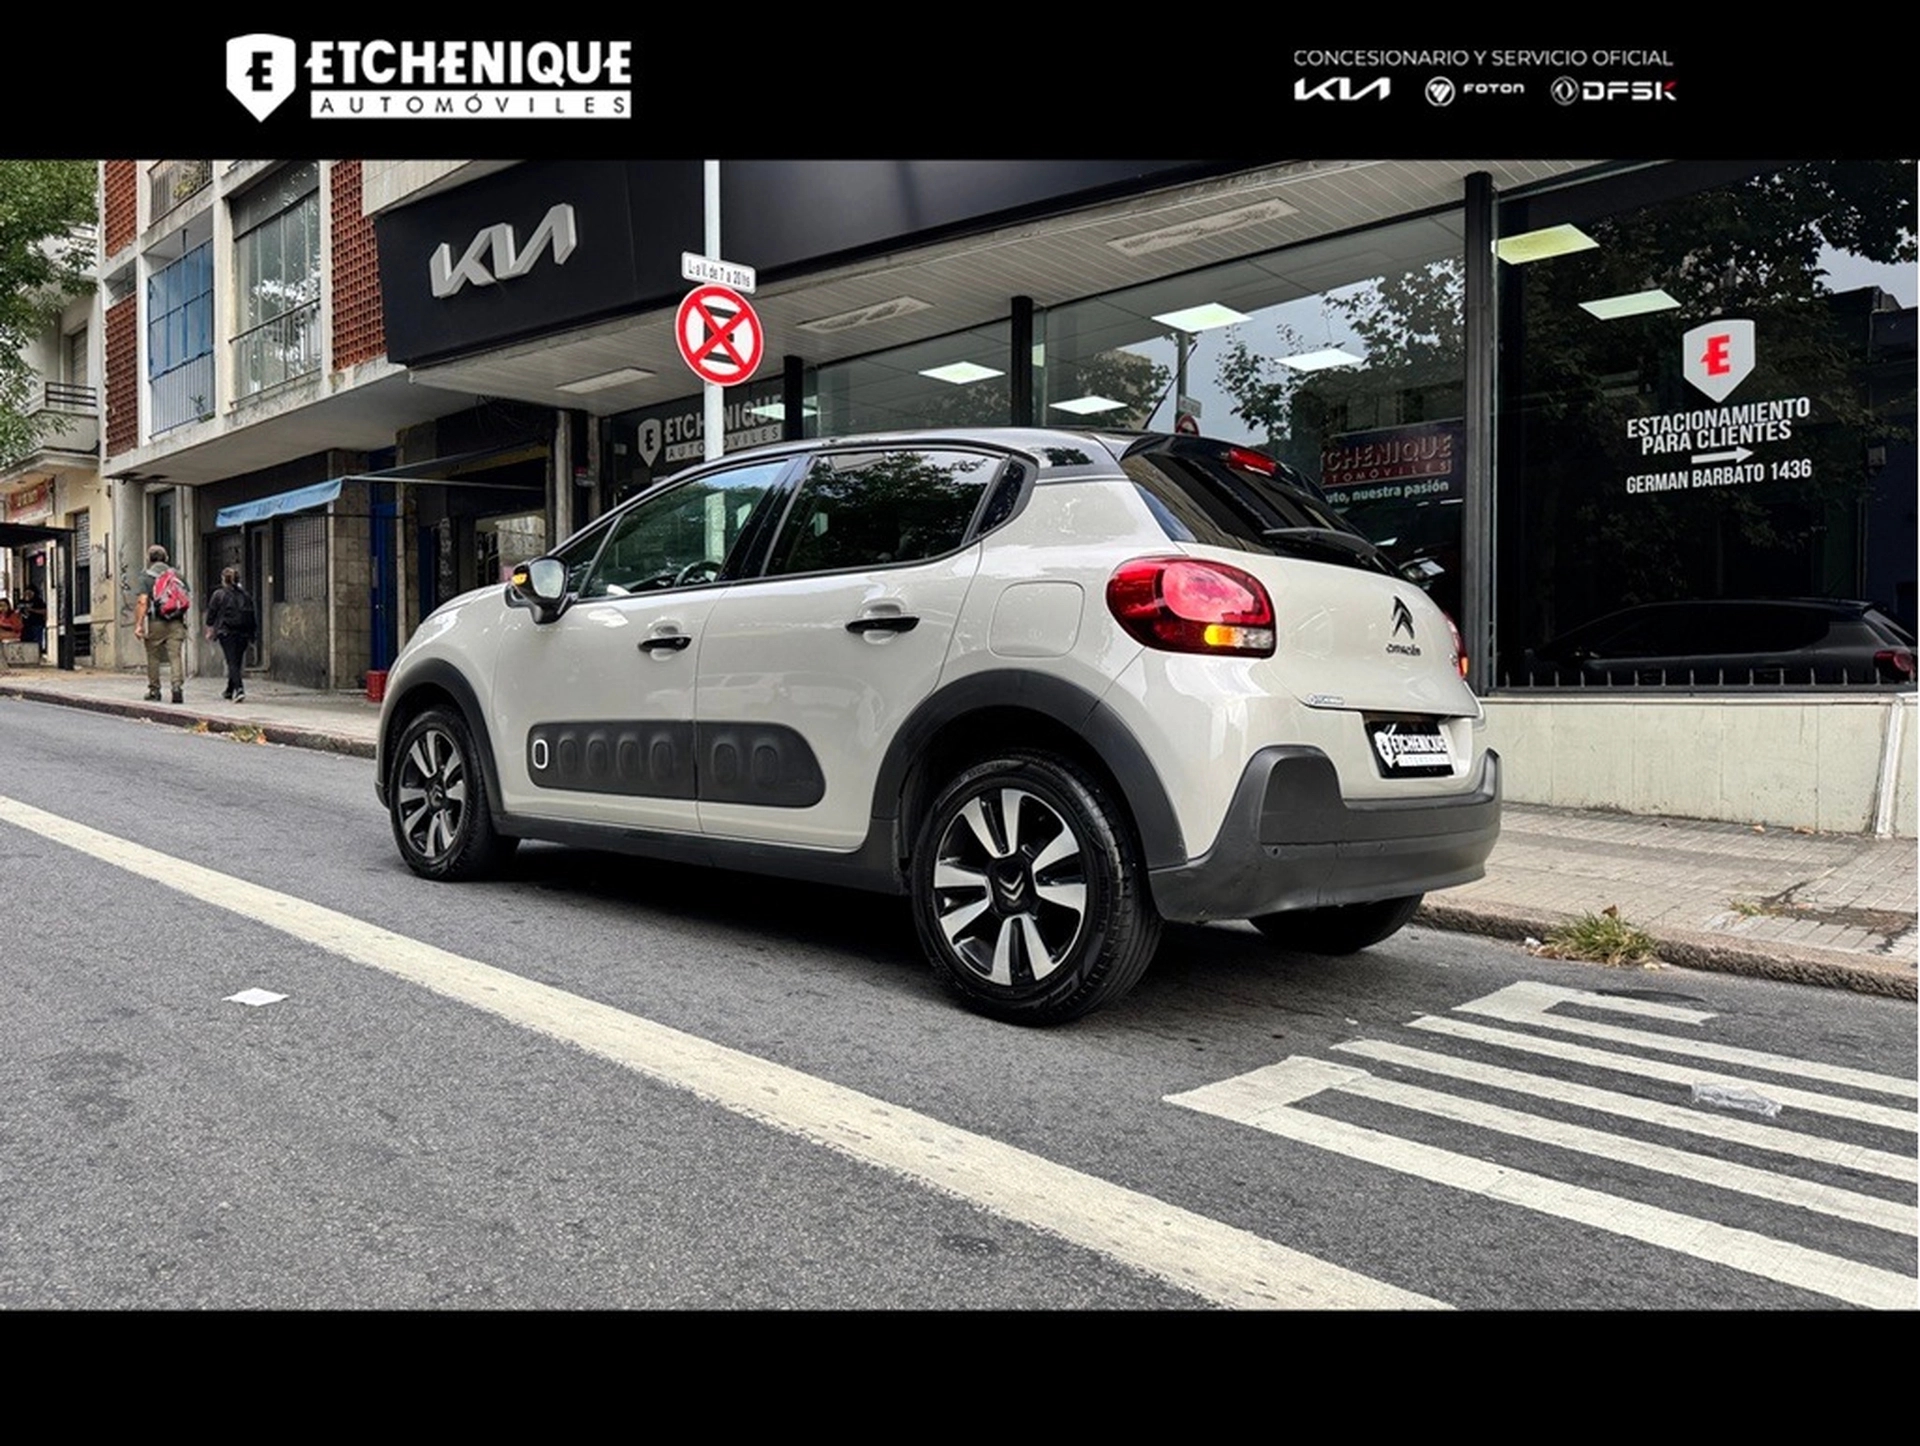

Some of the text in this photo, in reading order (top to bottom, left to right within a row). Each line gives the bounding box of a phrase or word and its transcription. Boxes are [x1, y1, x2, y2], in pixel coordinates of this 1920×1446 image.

[1626, 396, 1811, 439] ESTACIONAMIENTO
[1641, 419, 1792, 456] PARA CLIENTES
[1352, 486, 1402, 501] nuestra
[1404, 479, 1449, 498] pasión
[1626, 458, 1812, 494] GERMAN BARBATO 1436
